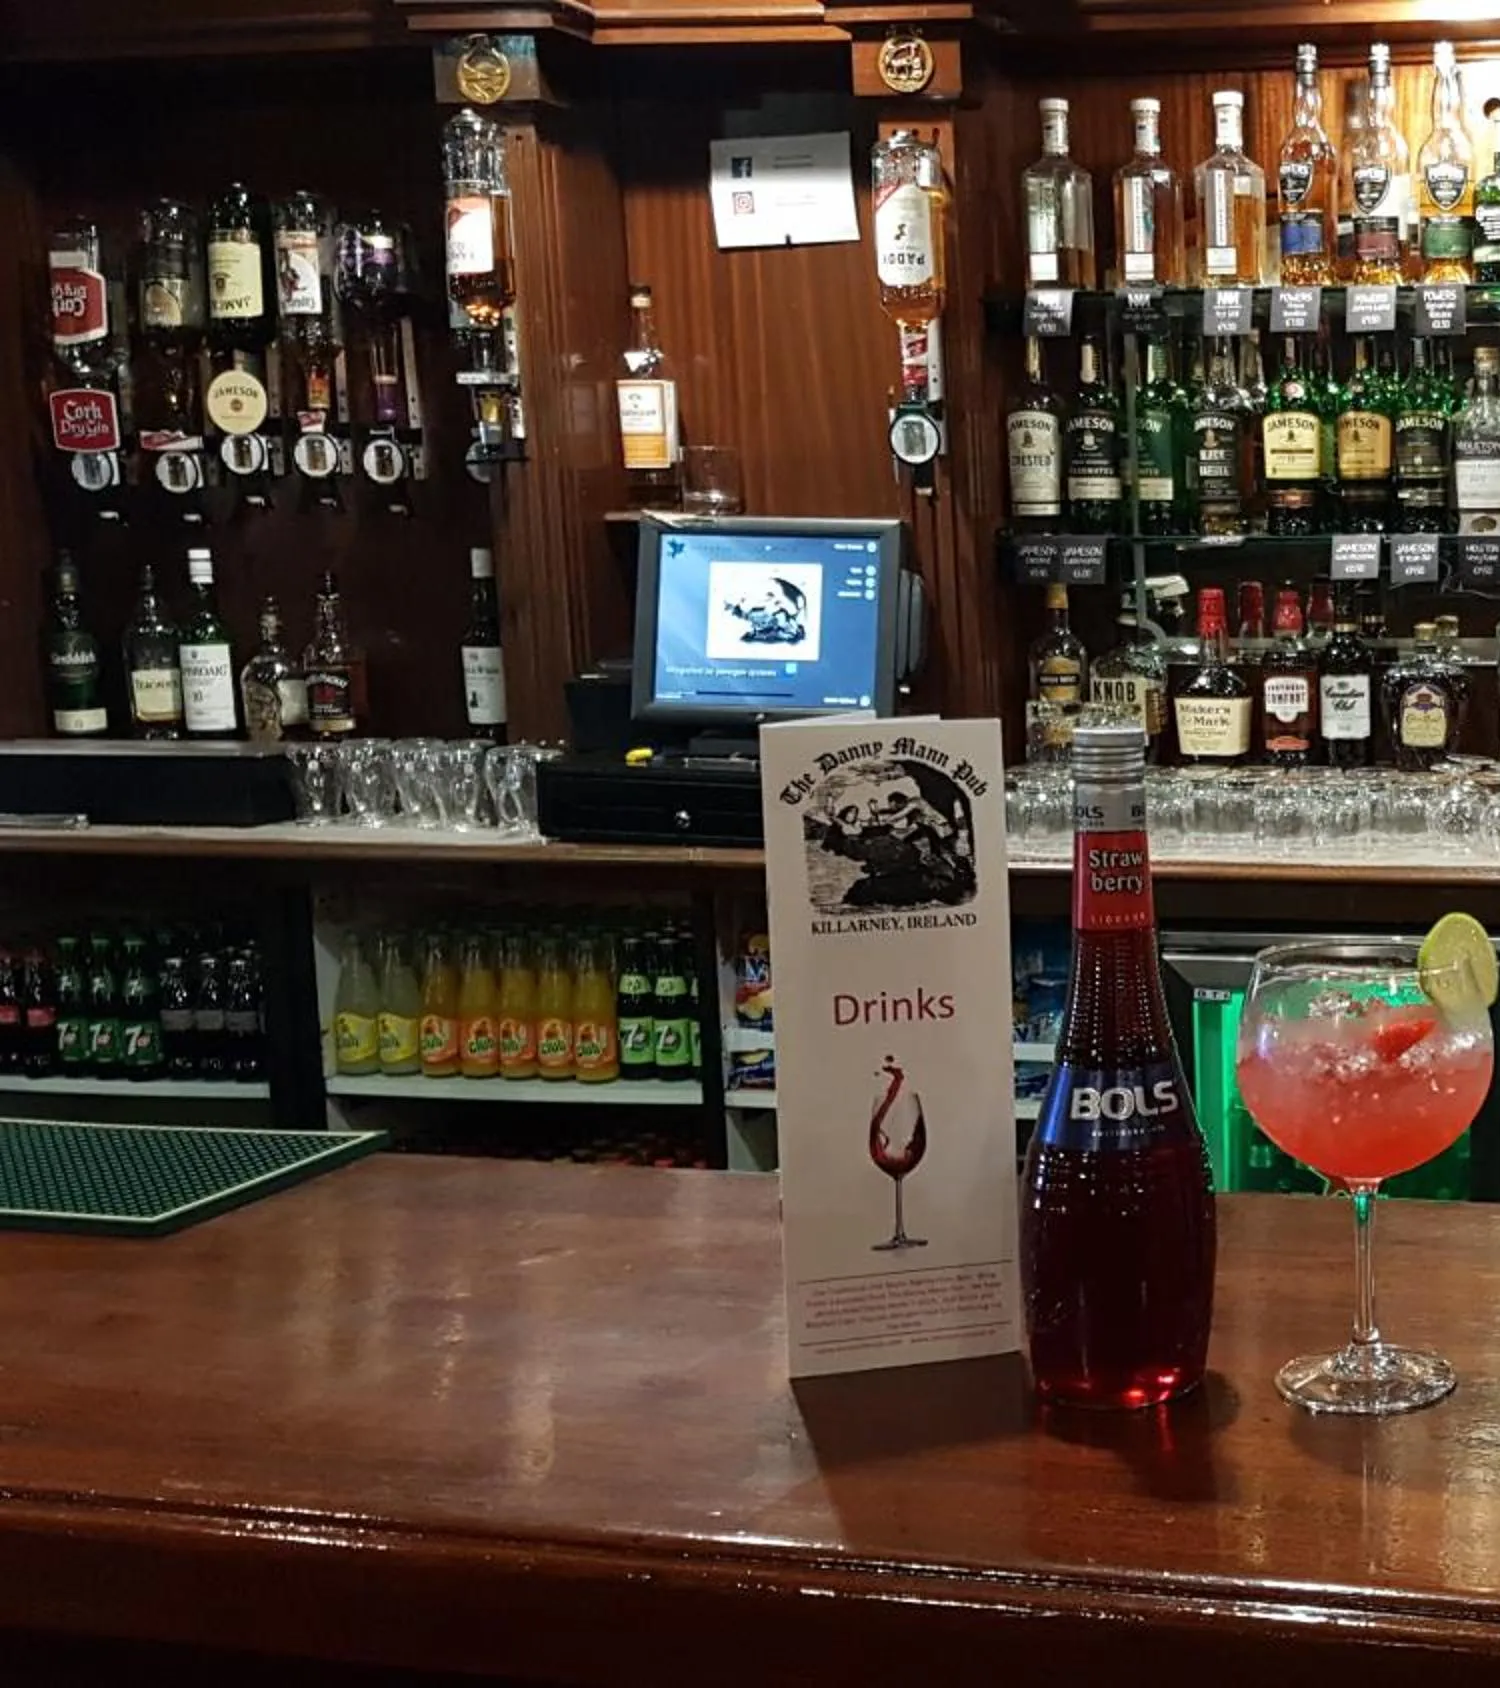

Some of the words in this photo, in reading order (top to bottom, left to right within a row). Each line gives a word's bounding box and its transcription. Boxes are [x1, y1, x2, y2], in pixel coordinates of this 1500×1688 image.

[882, 252, 926, 266] PADD
[213, 385, 258, 399] JAMESON
[63, 400, 103, 420] Cork
[61, 420, 87, 437] Dry
[1267, 417, 1316, 432] JAMESON
[1092, 681, 1137, 702] KNOB
[779, 771, 817, 806] The
[813, 741, 883, 776] Danny
[890, 737, 950, 766] Mann
[952, 760, 990, 798] Pub
[1089, 849, 1144, 868] Straw
[1091, 873, 1144, 895] berry
[811, 915, 904, 936] KILLARNEY,
[907, 912, 977, 931] IRELAND
[833, 987, 956, 1026] Drinks
[1069, 1080, 1180, 1121] BOLS
